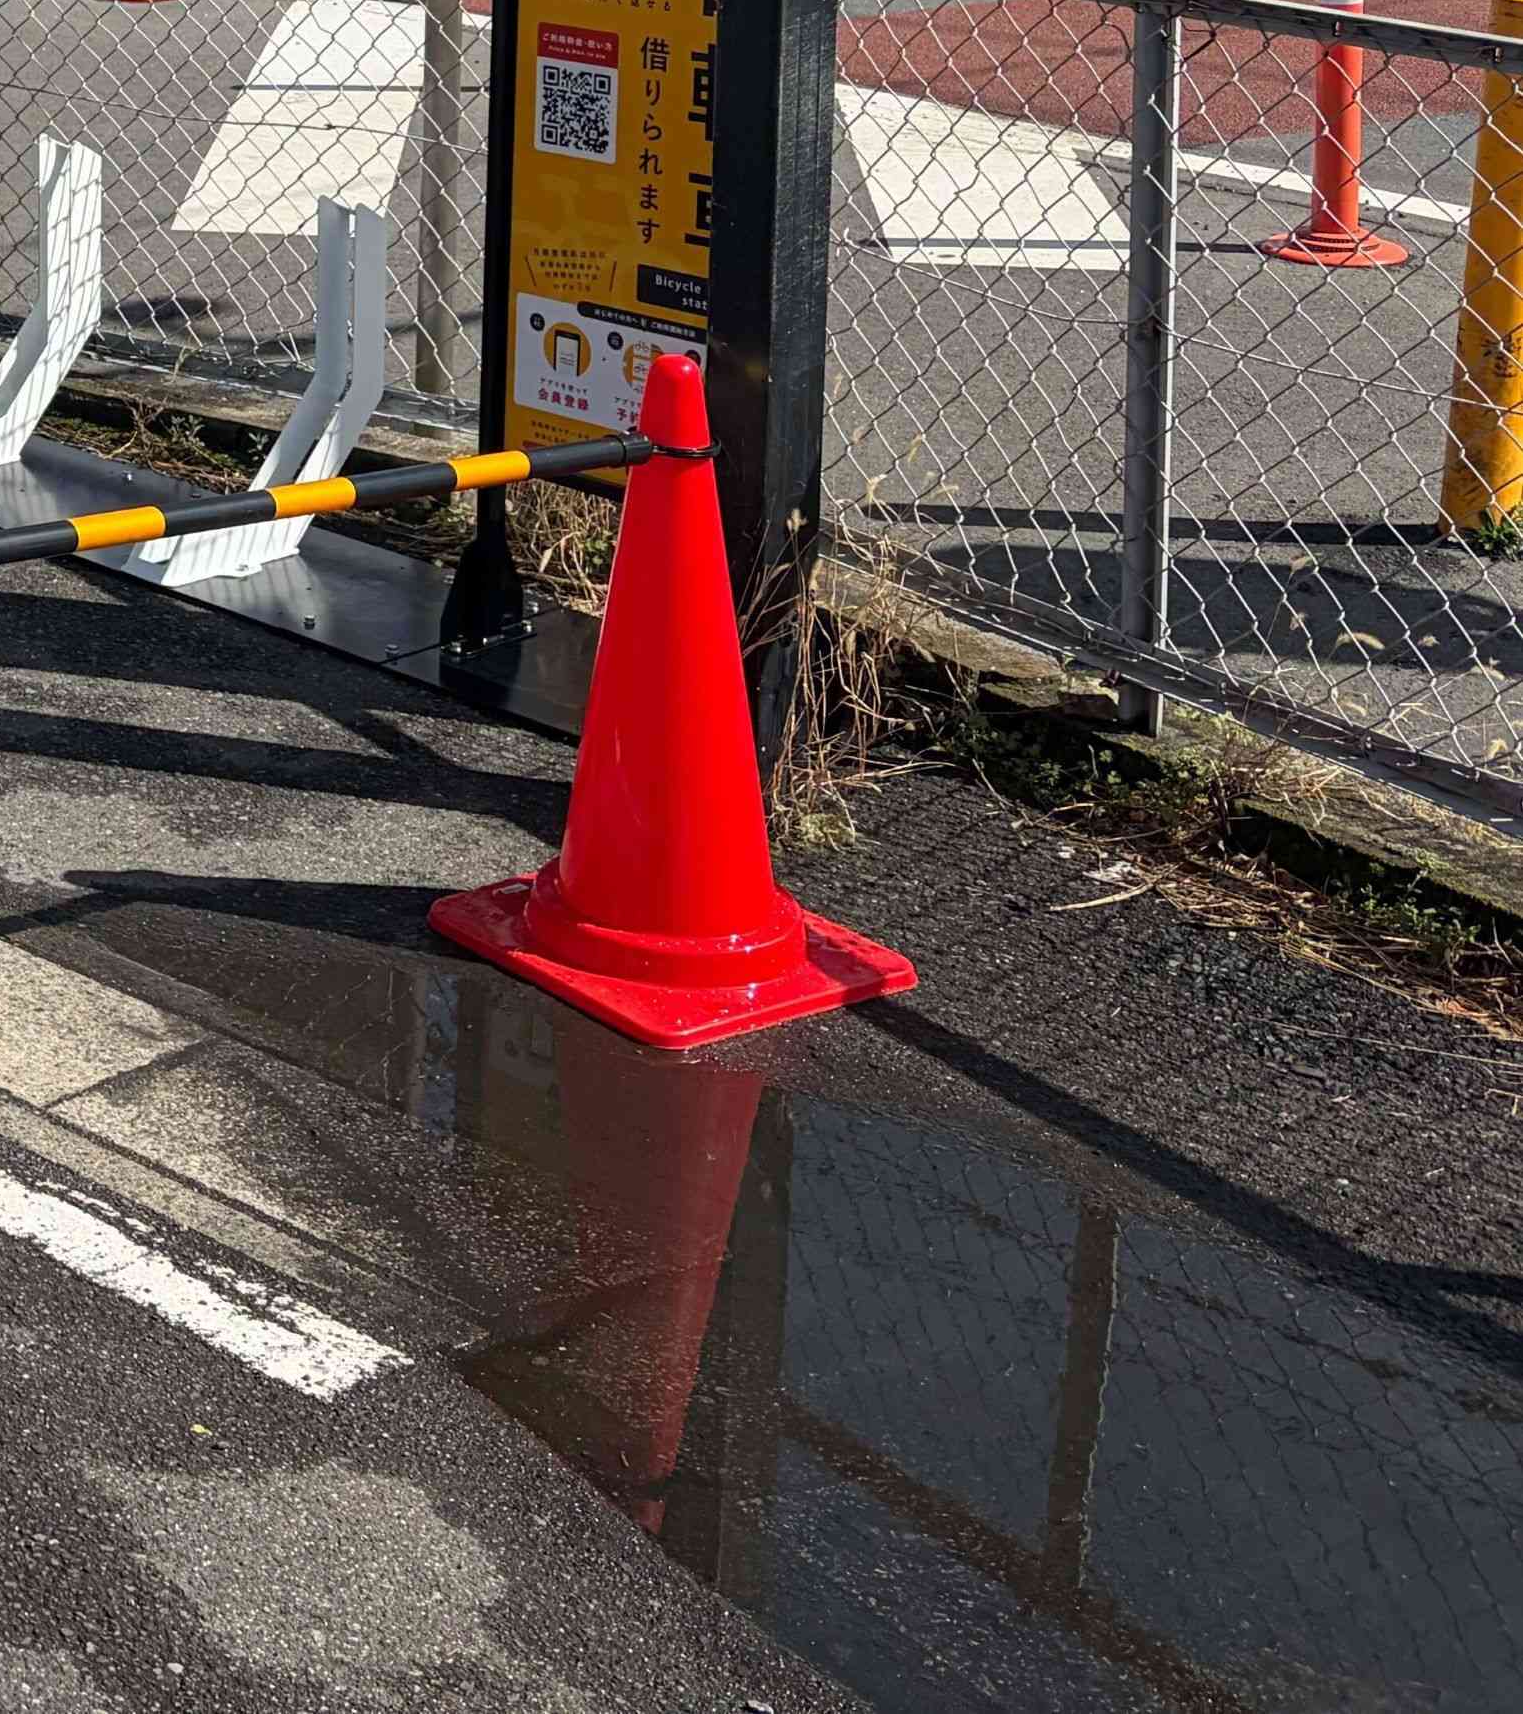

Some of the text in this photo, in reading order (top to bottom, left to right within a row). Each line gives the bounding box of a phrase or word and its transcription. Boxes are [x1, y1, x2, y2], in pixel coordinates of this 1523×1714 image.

[637, 36, 671, 244] 借りられます
[655, 273, 702, 295] Bicycle
[681, 297, 708, 311] stat
